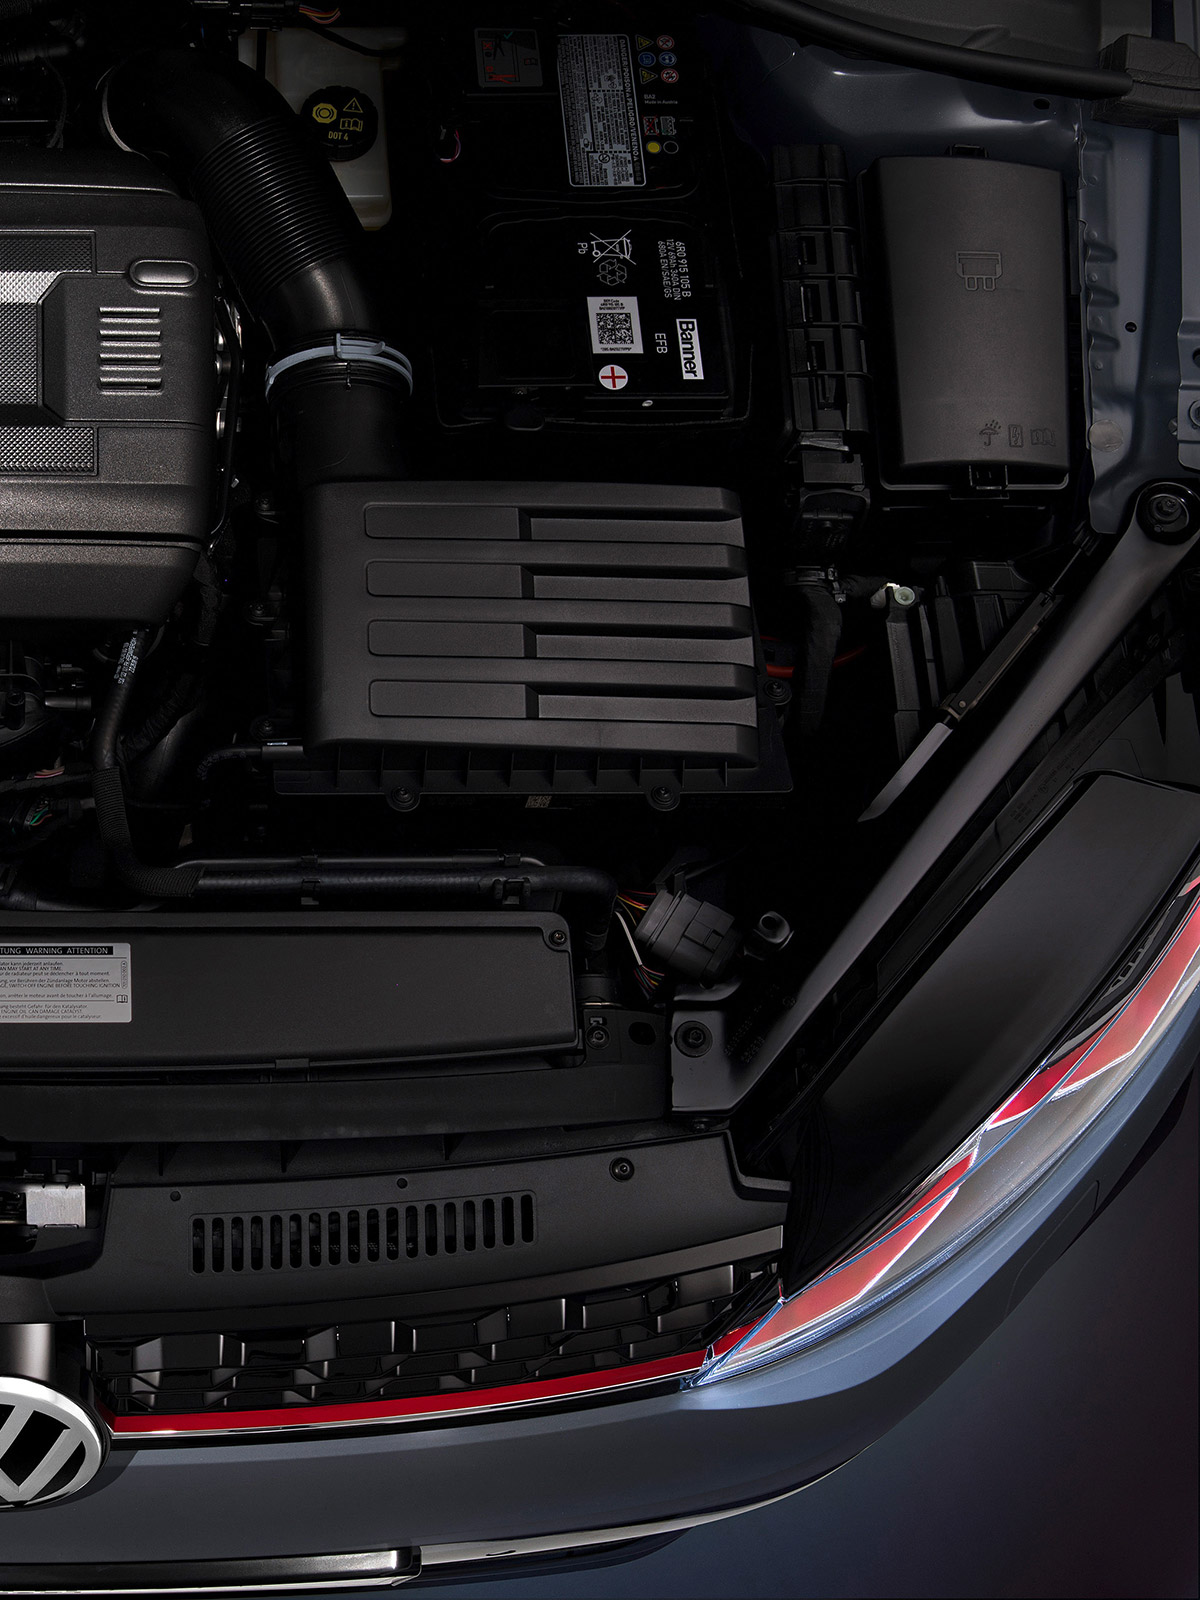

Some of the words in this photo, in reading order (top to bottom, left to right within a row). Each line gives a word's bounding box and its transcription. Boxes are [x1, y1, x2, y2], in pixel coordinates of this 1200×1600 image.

[328, 130, 343, 140] DOT
[343, 133, 349, 142] 4
[577, 242, 588, 254] Pb
[675, 241, 687, 257] 6R0
[666, 238, 674, 250] 12V
[672, 287, 682, 300] DIN
[679, 258, 689, 273] 915
[660, 258, 672, 298] EN/SAE/GS
[680, 275, 691, 290] 105
[654, 332, 668, 354] EFB
[679, 320, 698, 378] Banner
[26, 947, 62, 956] WARNING
[67, 947, 108, 956] ATTENTION
